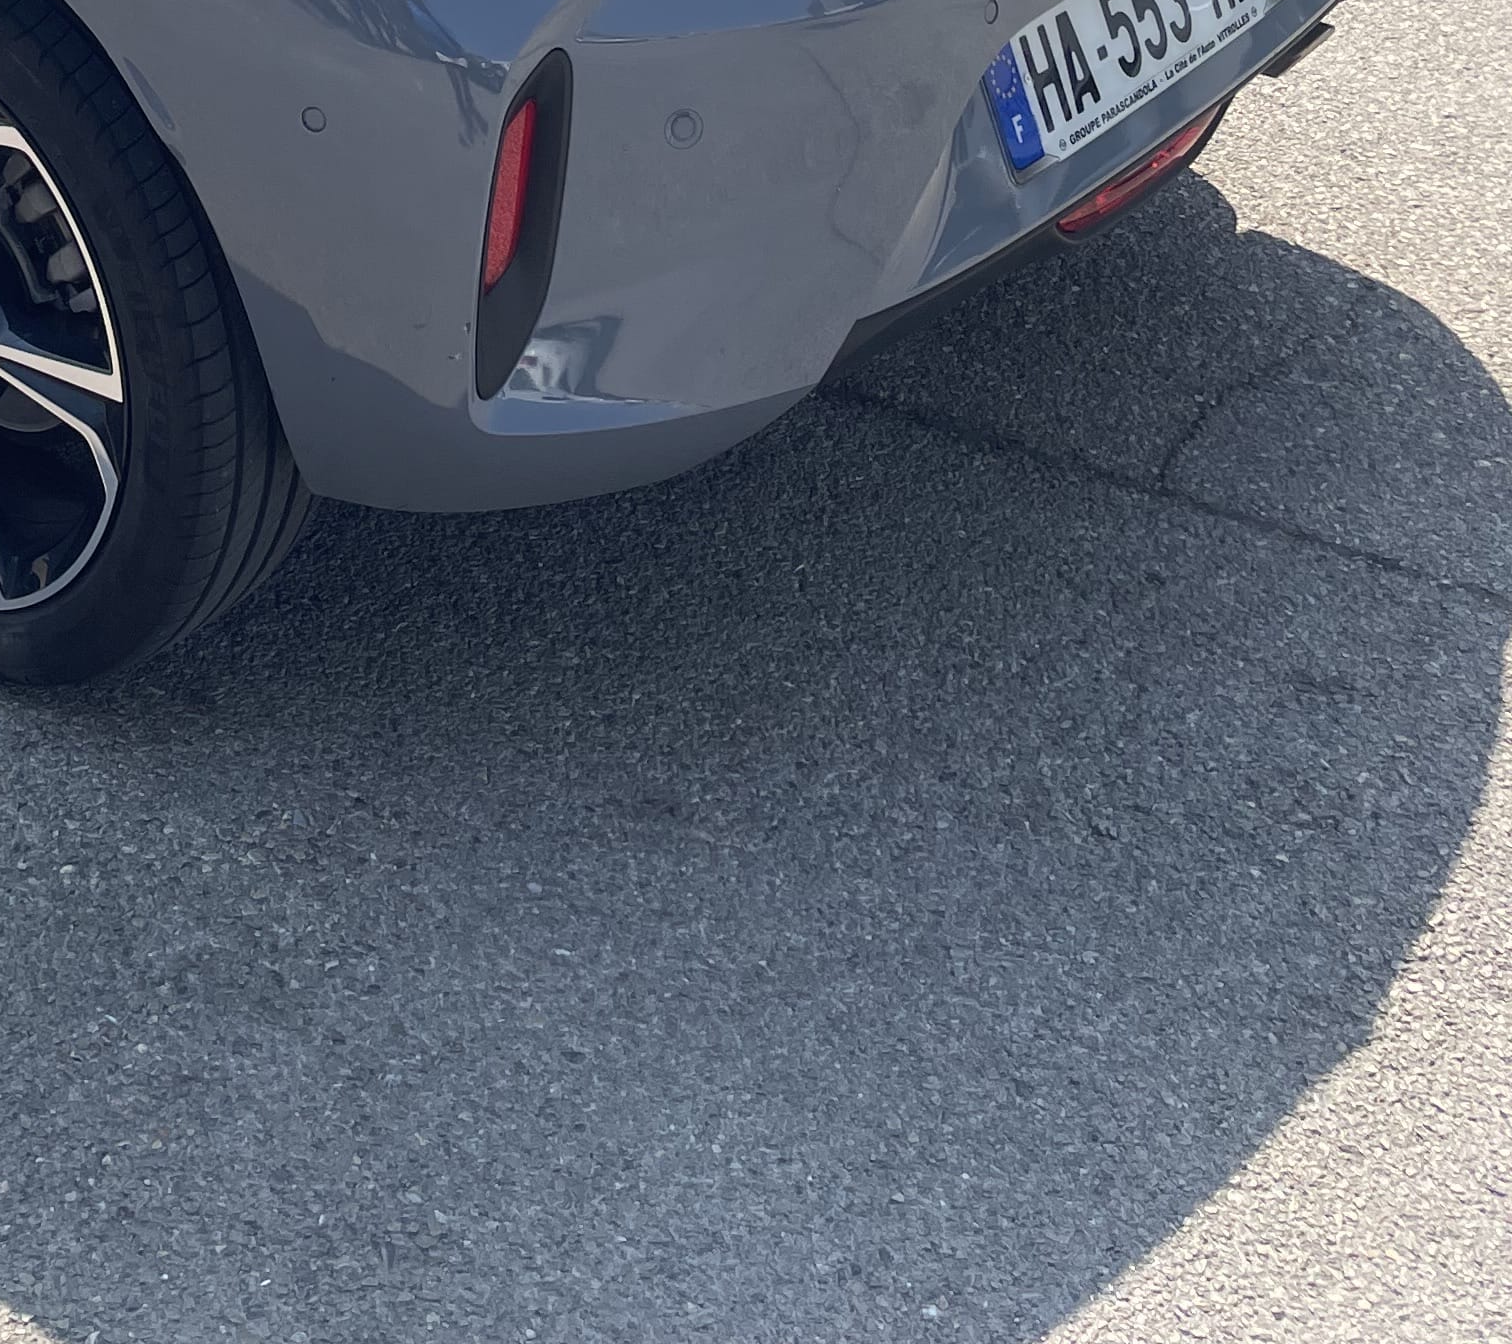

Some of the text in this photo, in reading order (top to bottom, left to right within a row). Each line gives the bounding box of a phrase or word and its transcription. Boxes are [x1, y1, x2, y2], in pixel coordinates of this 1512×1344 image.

[1011, 114, 1024, 144] F
[1069, 117, 1101, 145] GROUPE
[1101, 79, 1158, 124] PARASCANDOLA
